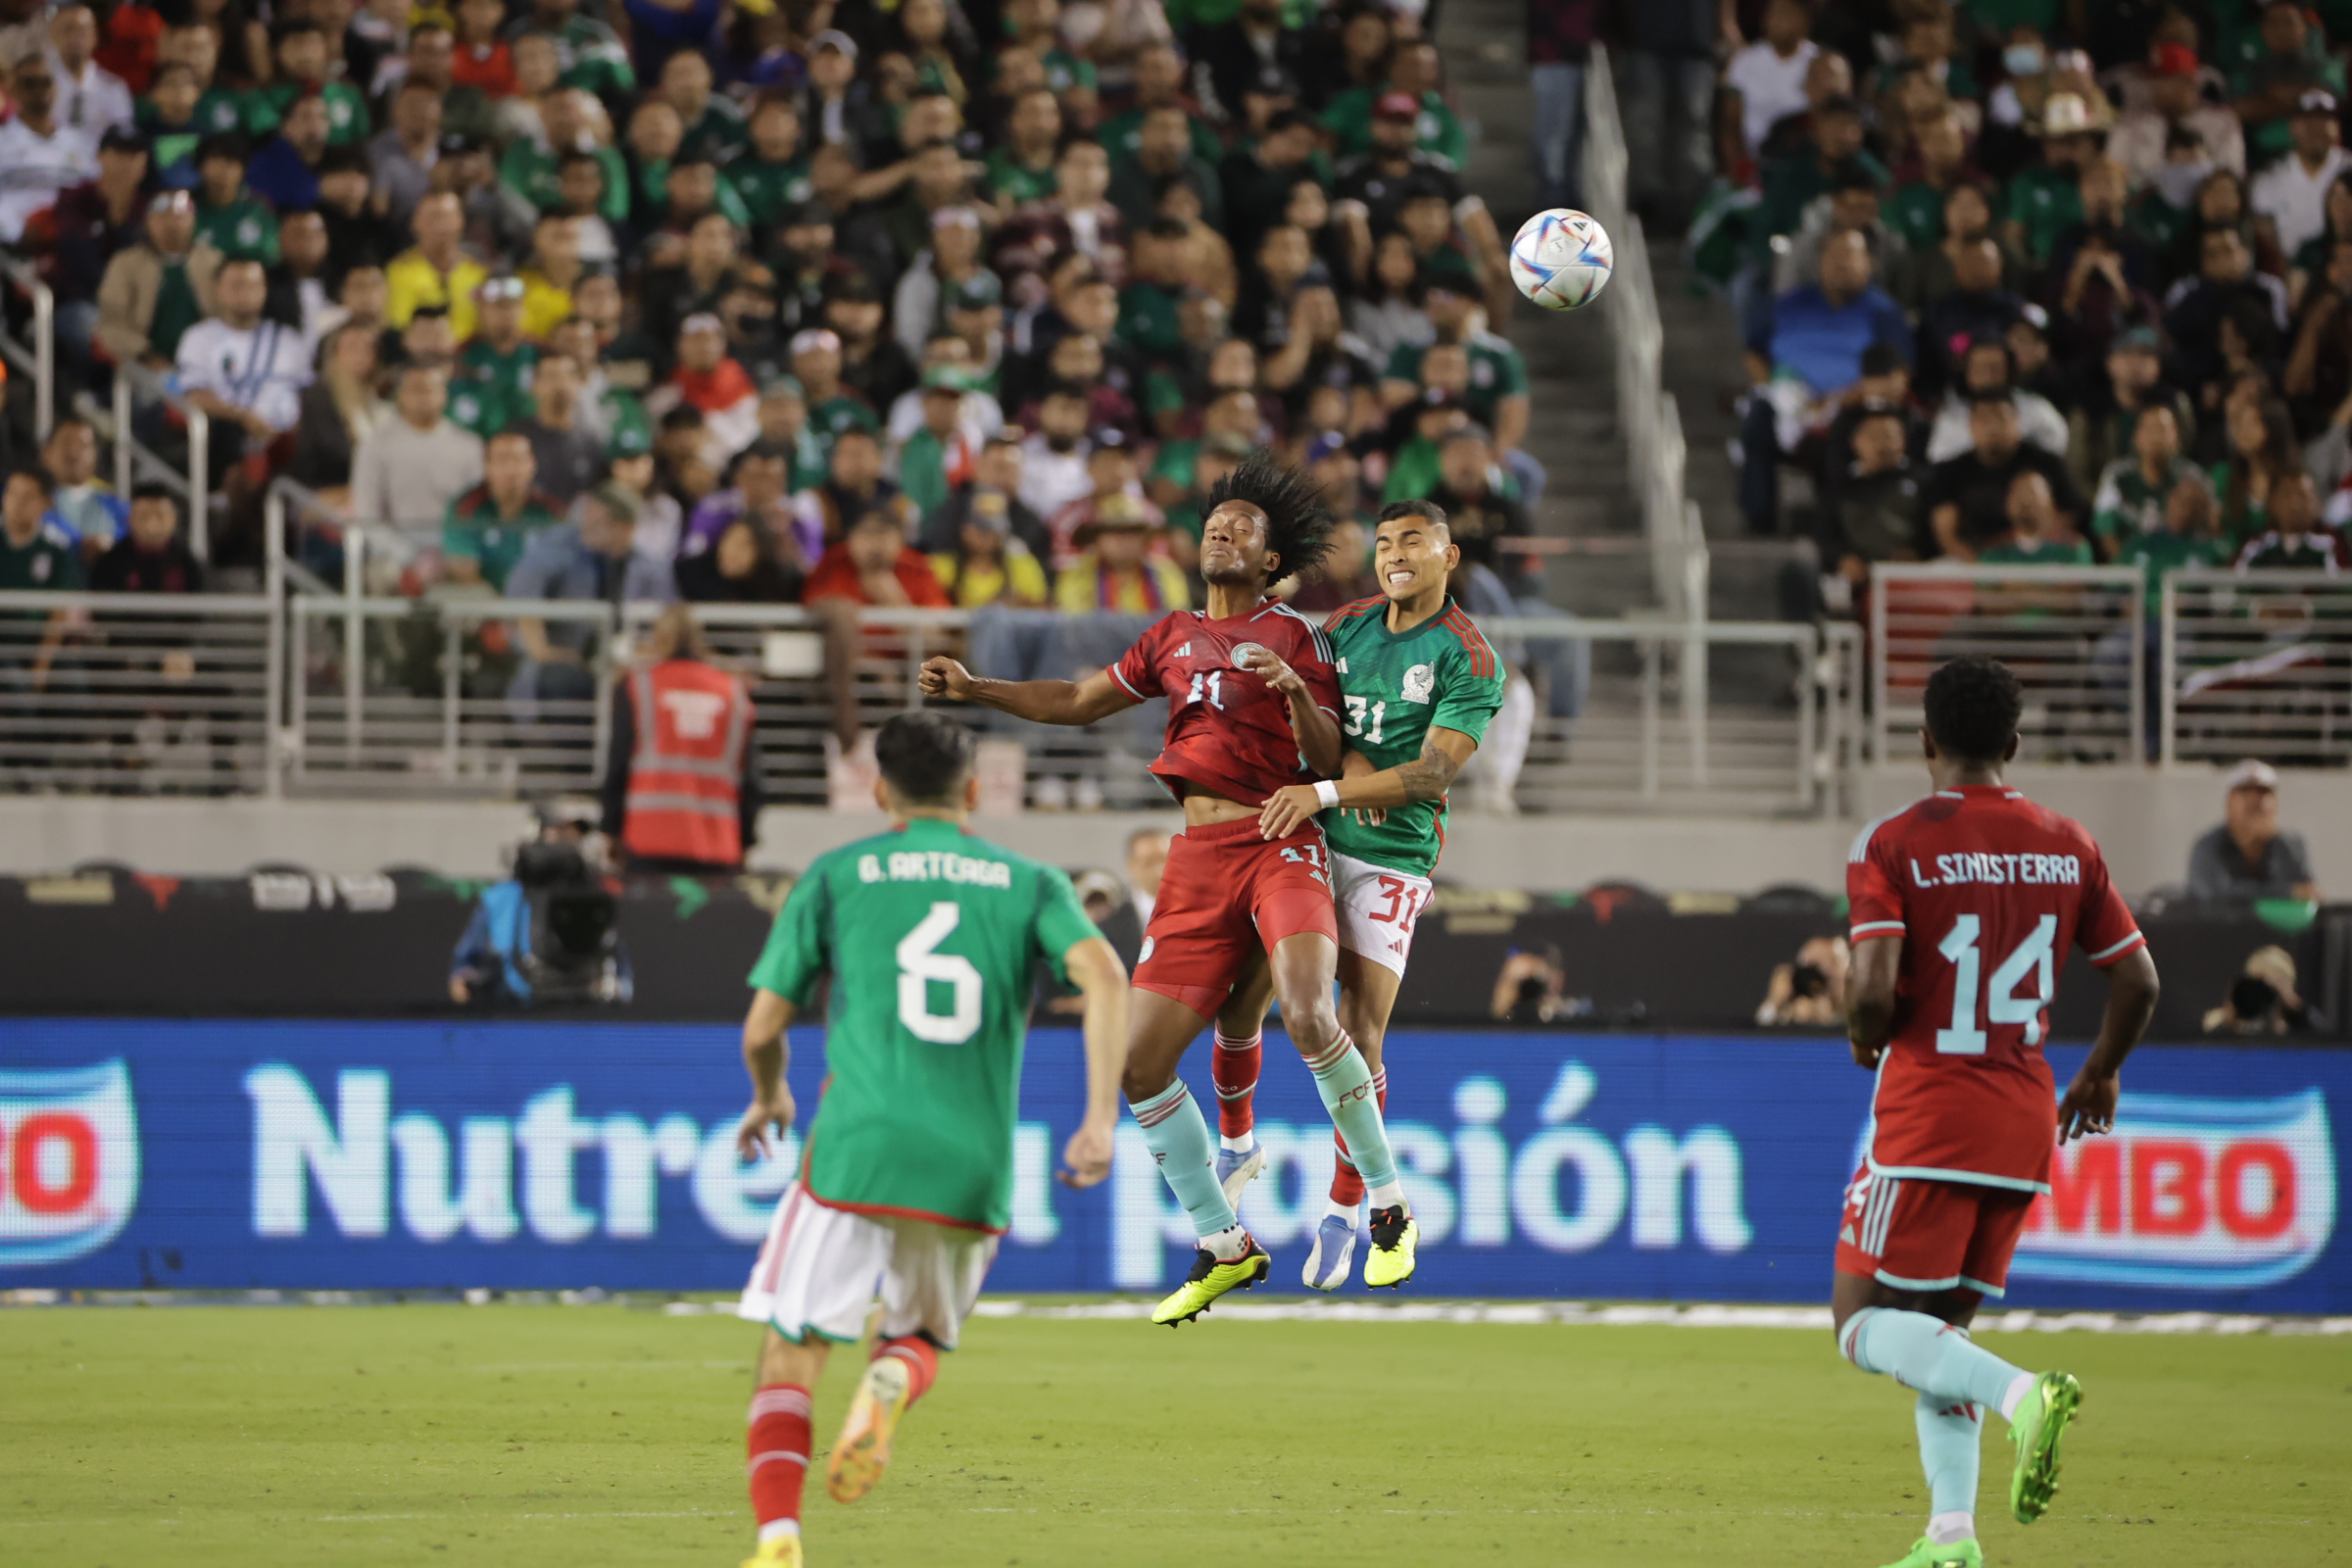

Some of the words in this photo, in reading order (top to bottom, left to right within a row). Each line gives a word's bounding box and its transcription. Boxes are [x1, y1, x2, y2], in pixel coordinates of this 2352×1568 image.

[1186, 670, 1225, 710] 11
[1344, 694, 1387, 745] 31
[1280, 844, 1322, 868] 11
[1369, 874, 1419, 933] 31
[896, 901, 984, 1045] 6
[1936, 912, 2058, 1055] 14
[1339, 1079, 1372, 1108] FCF
[0, 1109, 96, 1213] O
[245, 1061, 808, 1245] Nutre
[2022, 1137, 2294, 1242] MBO
